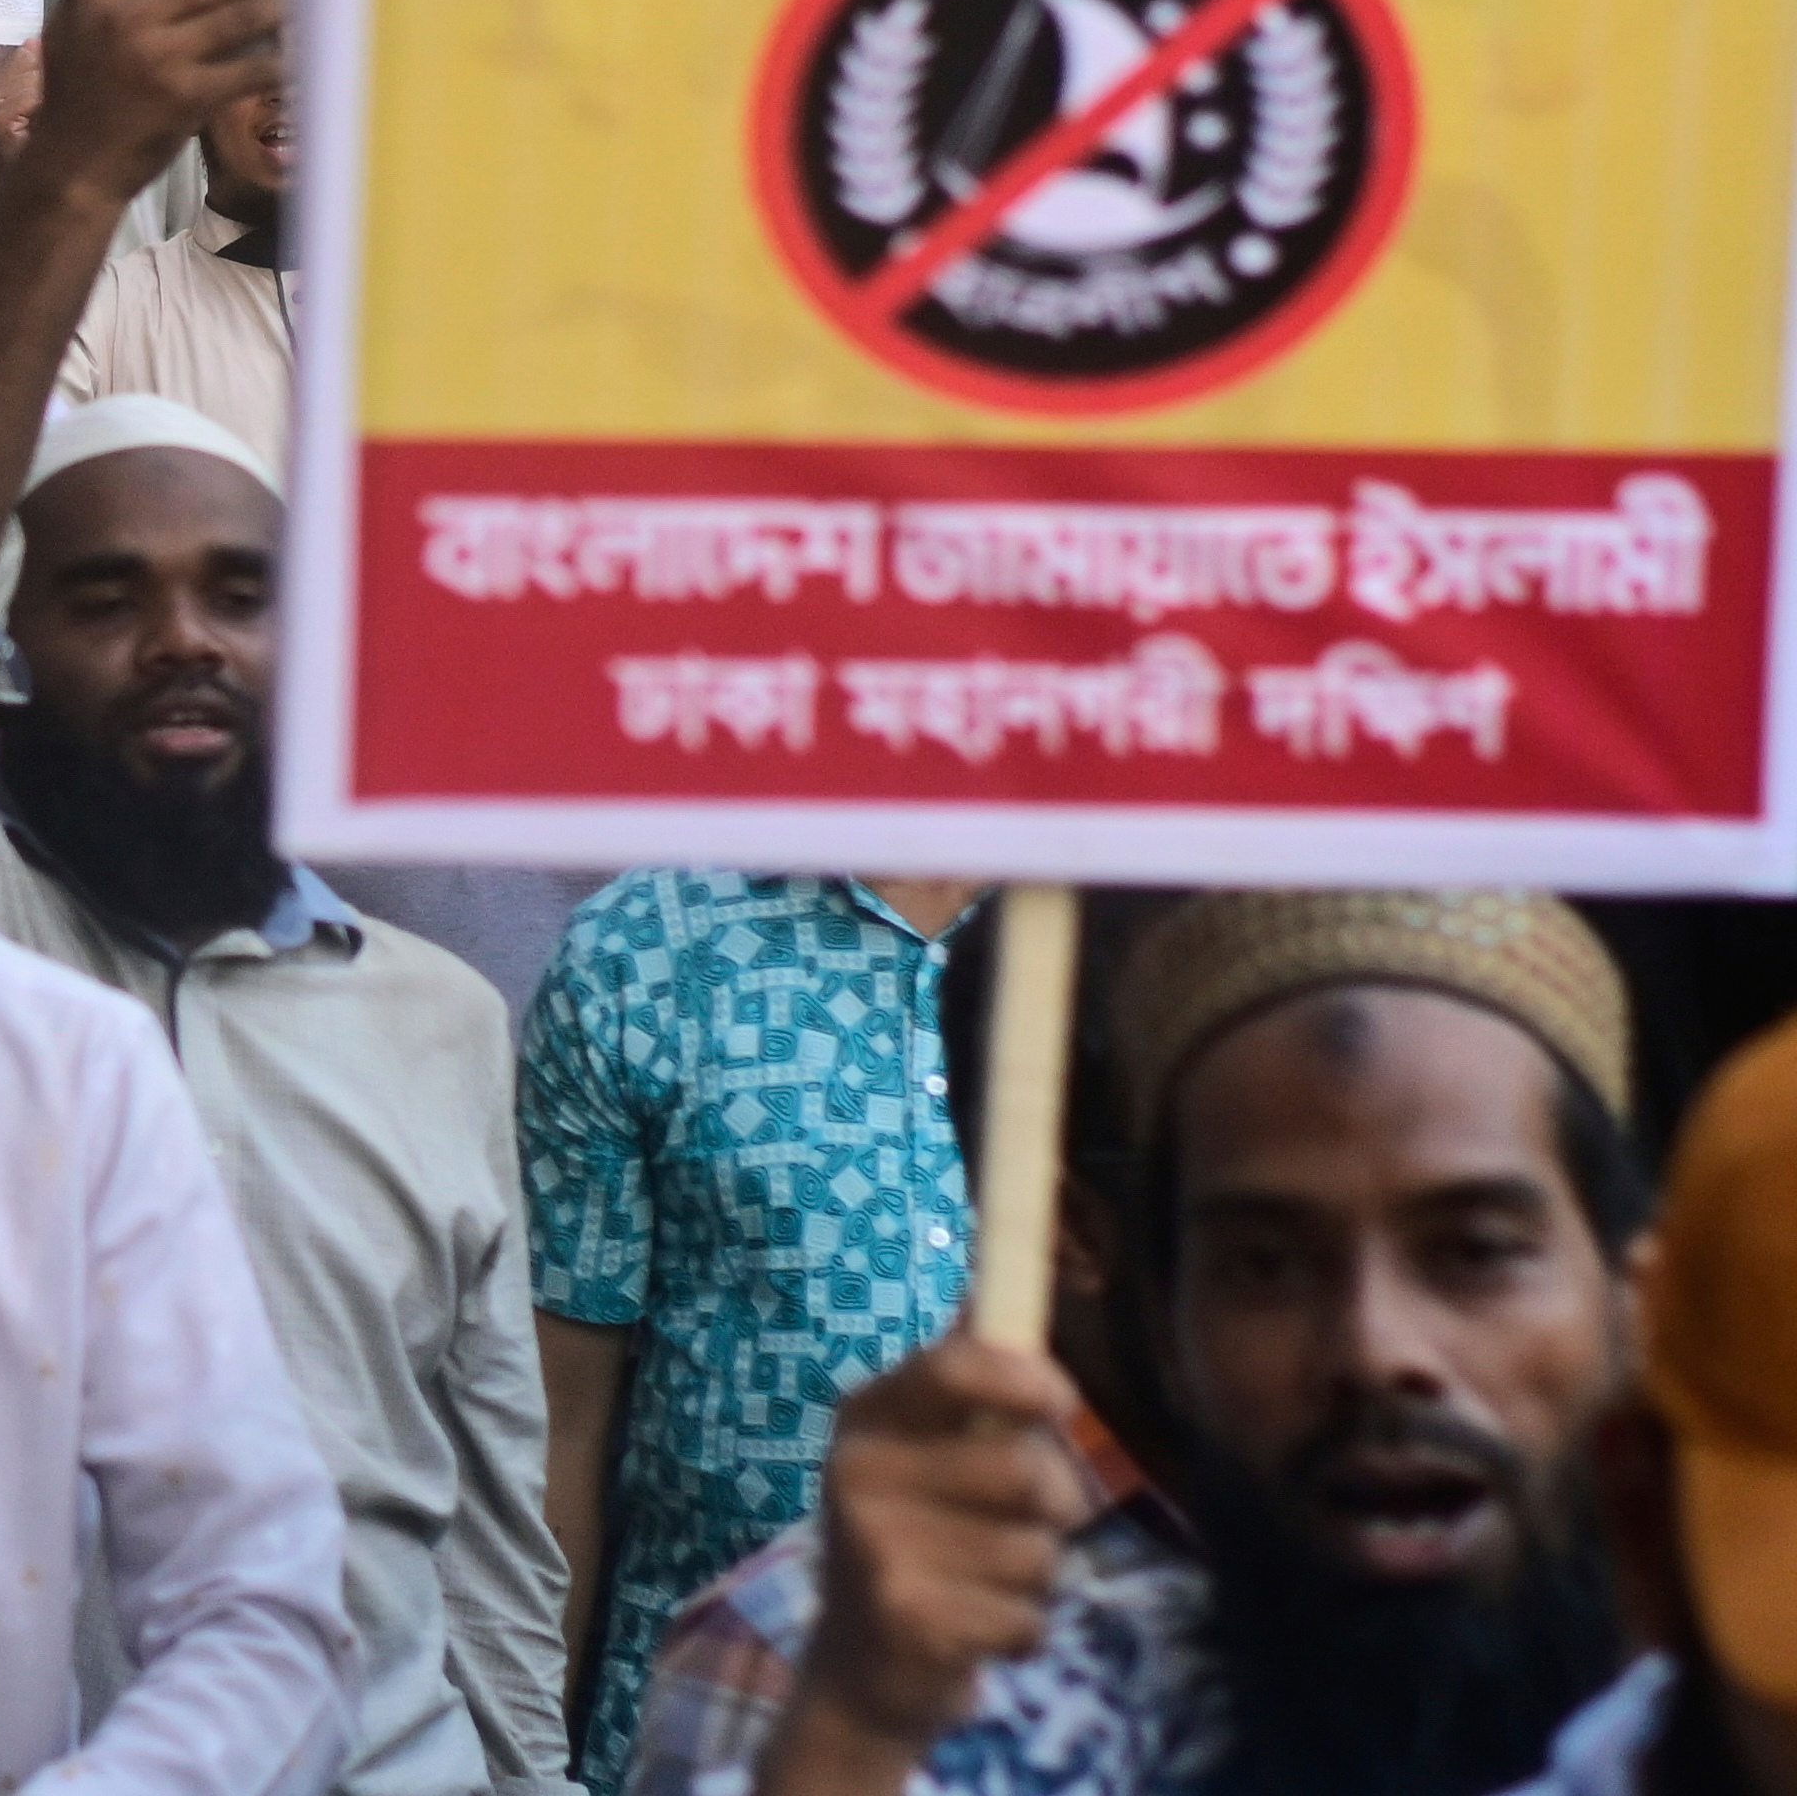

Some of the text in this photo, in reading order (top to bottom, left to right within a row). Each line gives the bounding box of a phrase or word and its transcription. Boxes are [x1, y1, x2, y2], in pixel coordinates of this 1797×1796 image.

[417, 472, 1717, 624] বাংলাদেশ জামায়াতে ইসলামী
[606, 633, 1516, 765] ঢাকা মহানগরী দক্ষিণ
